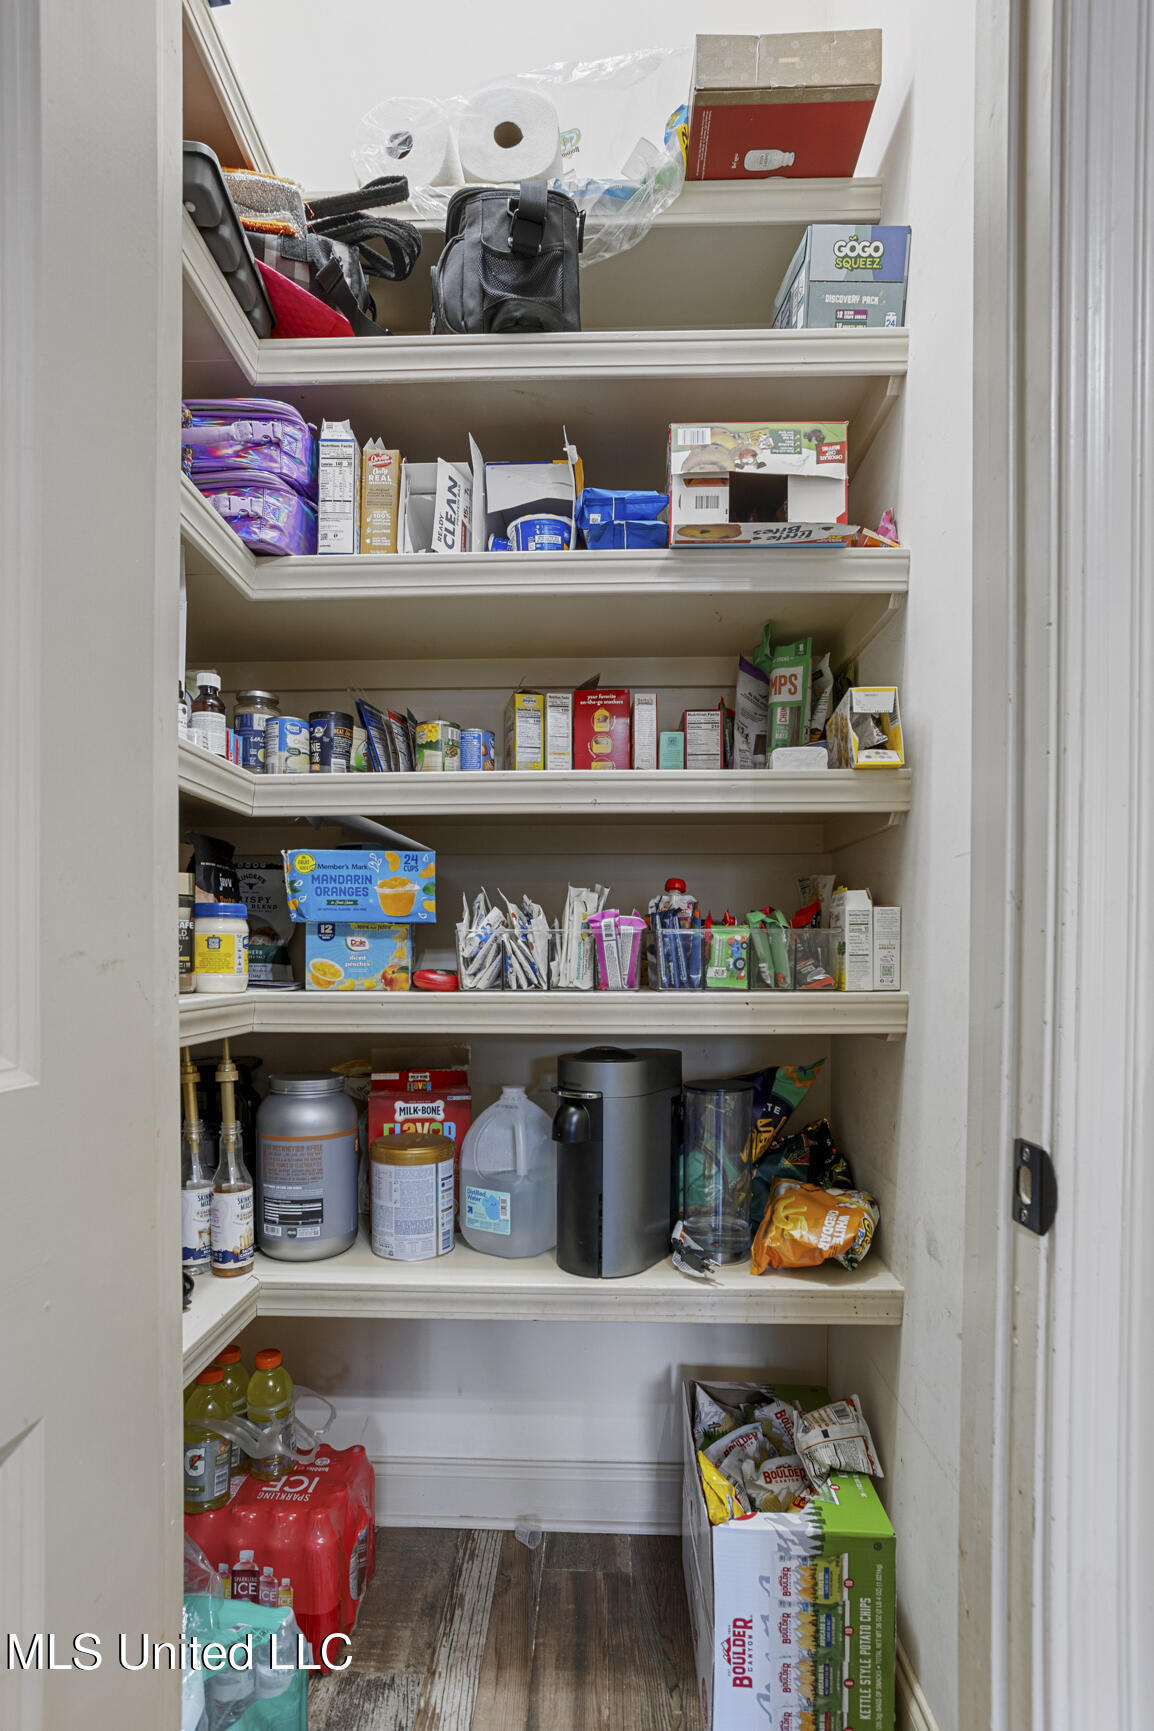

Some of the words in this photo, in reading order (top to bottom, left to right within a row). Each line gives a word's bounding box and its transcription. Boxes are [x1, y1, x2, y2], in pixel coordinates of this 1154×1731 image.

[825, 294, 860, 303] DISCOVERY
[862, 295, 879, 305] PACK
[886, 319, 895, 328] 24
[443, 475, 458, 550] CLEAN
[404, 854, 418, 865] 24
[403, 865, 419, 873] CUPS
[311, 874, 373, 885] MANDARIN
[315, 887, 369, 897] ORANGES
[320, 925, 333, 933] 12
[350, 939, 367, 947] Dole
[831, 1215, 850, 1246] WHITE
[185, 1447, 206, 1476] G
[256, 1492, 311, 1502] SPARKLING
[233, 1583, 257, 1595] ICE
[782, 1567, 791, 1596] BOULDER
[259, 1591, 277, 1601] ICE
[860, 1598, 871, 1621] CHIPS
[782, 1613, 791, 1644] BOULDER
[860, 1625, 871, 1655] POTATO
[732, 1618, 753, 1688] BOULDER
[782, 1663, 791, 1693] BOULDER
[860, 1658, 871, 1685] STYLE
[860, 1688, 871, 1720] KETTLE
